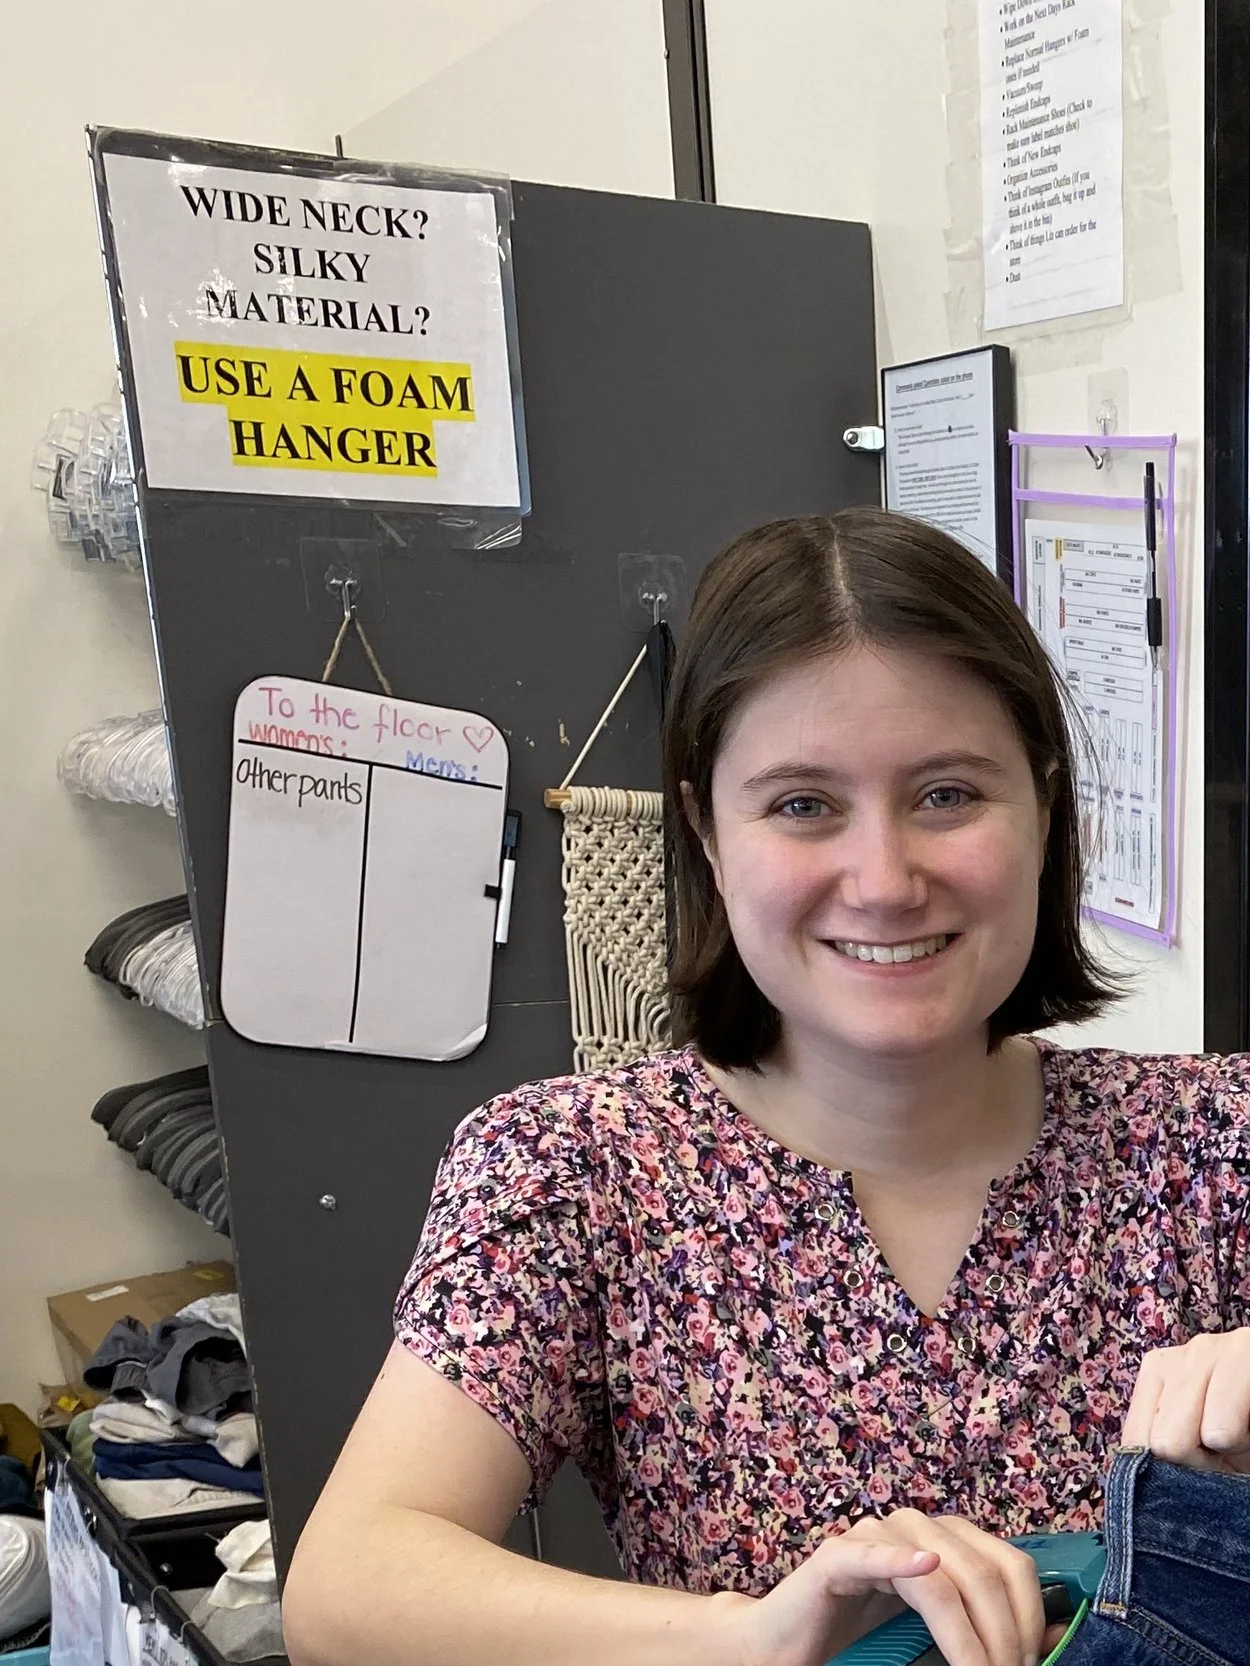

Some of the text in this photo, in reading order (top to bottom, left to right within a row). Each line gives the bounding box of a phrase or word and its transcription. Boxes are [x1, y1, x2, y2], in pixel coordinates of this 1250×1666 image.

[180, 185, 430, 241] WIDE NECK?
[253, 243, 372, 284] SILKY
[205, 288, 431, 336] MATERIAL?
[178, 355, 473, 412] USE A FOAM
[230, 420, 437, 468] HANGER
[258, 687, 452, 745] To the floor
[236, 757, 363, 808] Other pants
